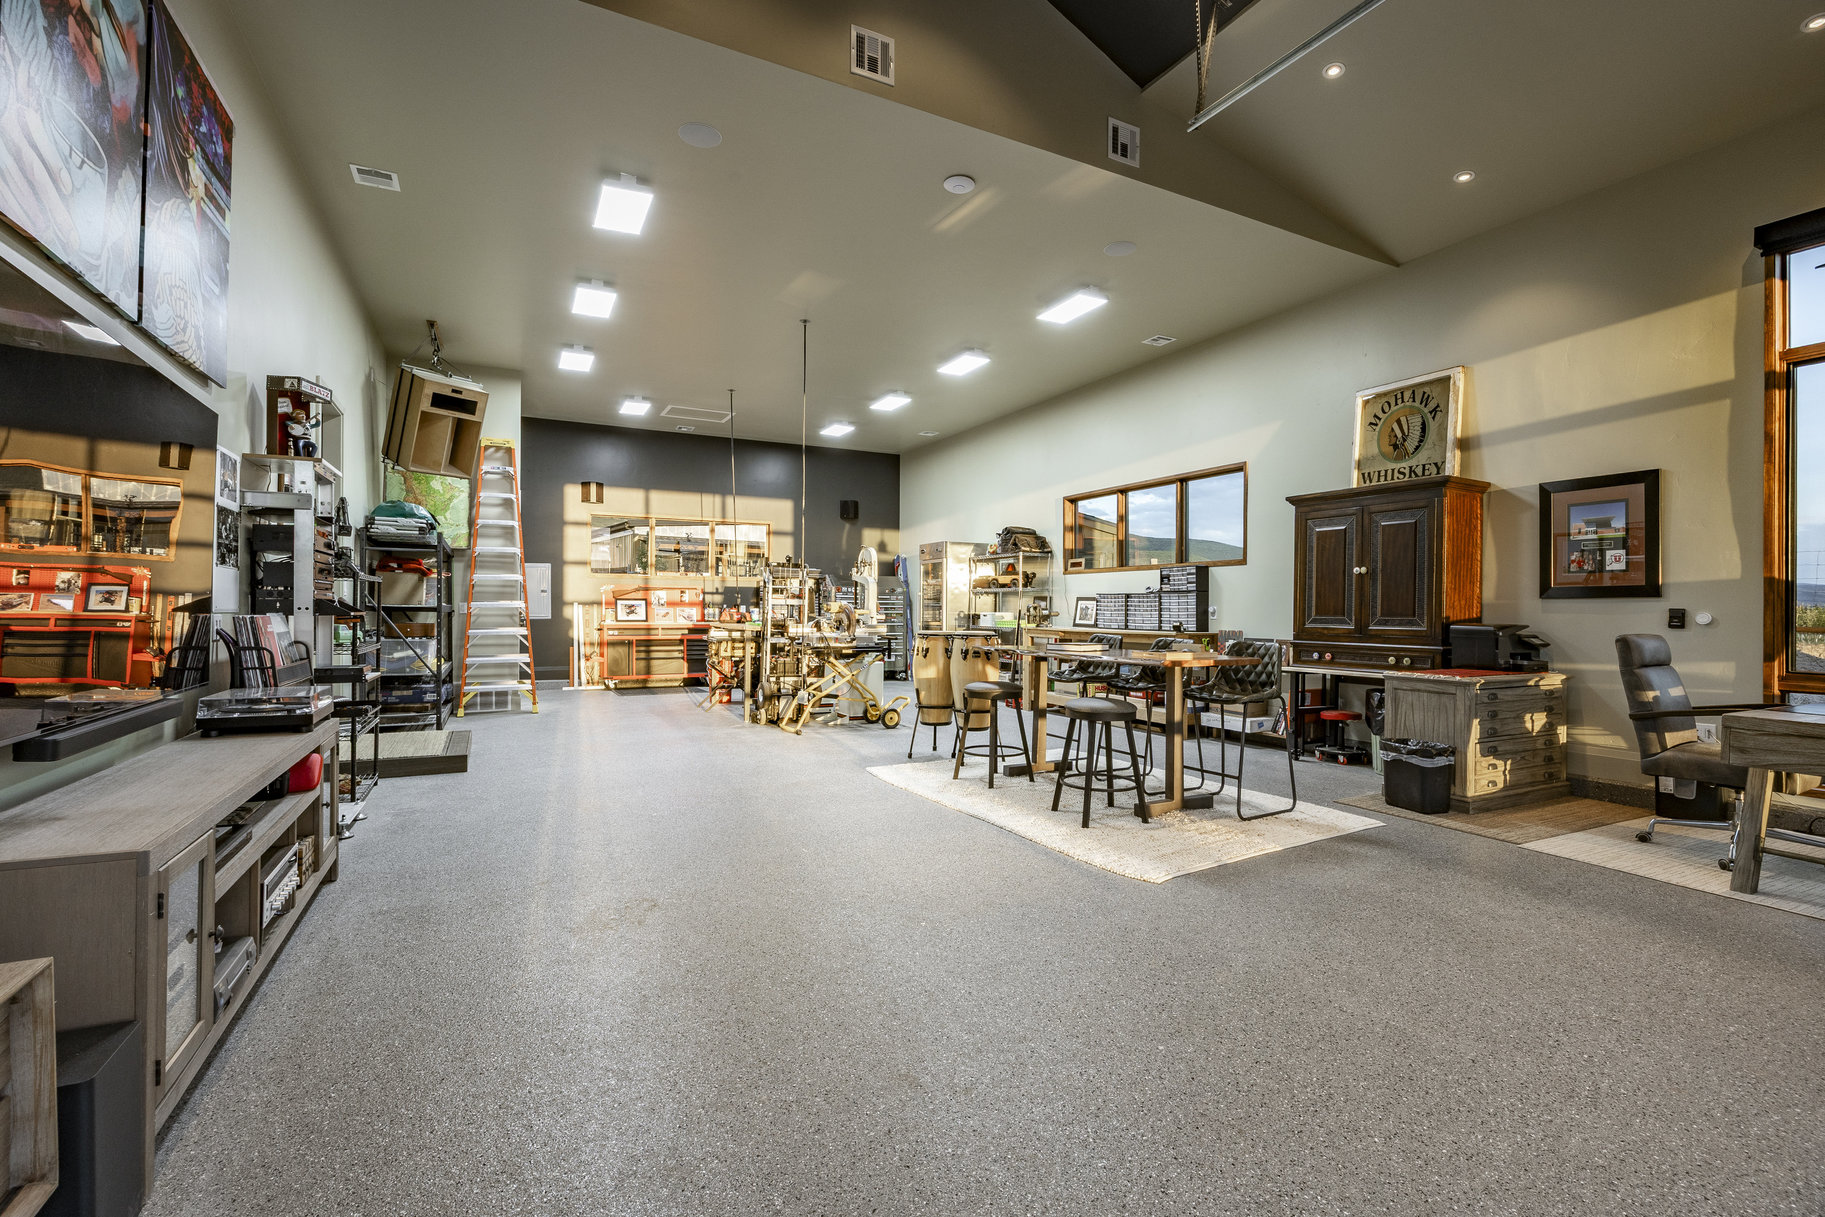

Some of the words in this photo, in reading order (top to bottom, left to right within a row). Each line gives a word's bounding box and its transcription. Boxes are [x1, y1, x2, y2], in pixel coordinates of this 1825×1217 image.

[309, 385, 330, 398] BLATZ
[1367, 389, 1443, 432] MOHAWK
[1361, 461, 1445, 484] WHISKEY
